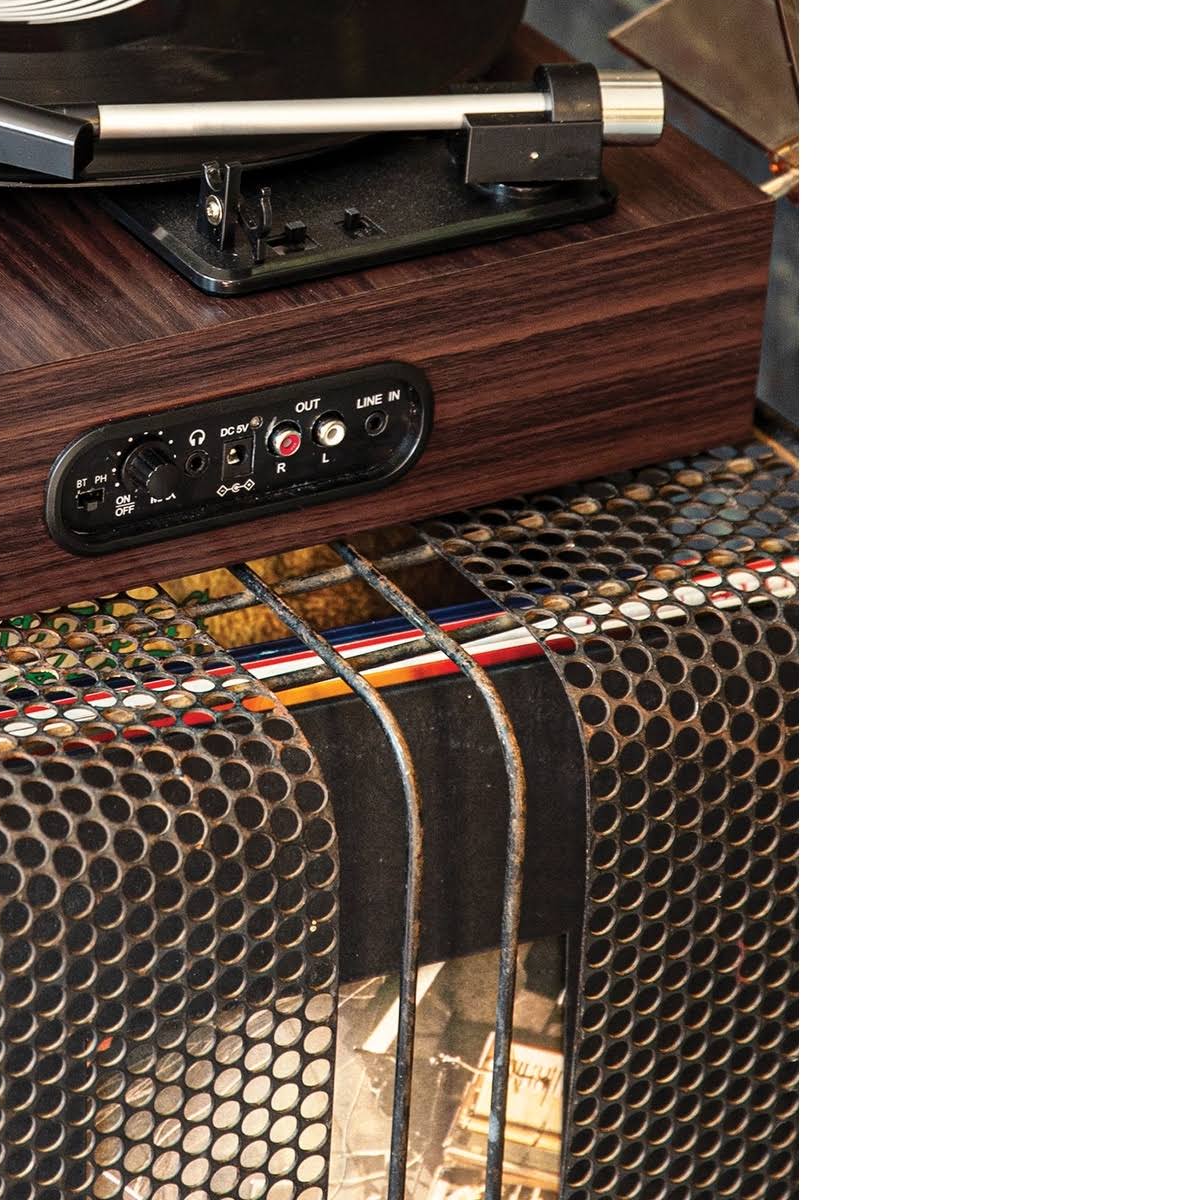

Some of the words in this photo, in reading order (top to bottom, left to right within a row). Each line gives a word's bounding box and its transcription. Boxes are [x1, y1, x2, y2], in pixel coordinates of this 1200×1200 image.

[356, 394, 383, 409] LINE
[388, 389, 401, 402] IN
[295, 398, 321, 413] OUT
[220, 427, 235, 437] DC
[236, 423, 249, 433] 5V
[322, 453, 330, 463] L
[276, 463, 287, 473] R
[76, 478, 88, 489] BT
[94, 474, 107, 484] PH
[115, 494, 131, 505] ON
[115, 505, 135, 517] OFF
